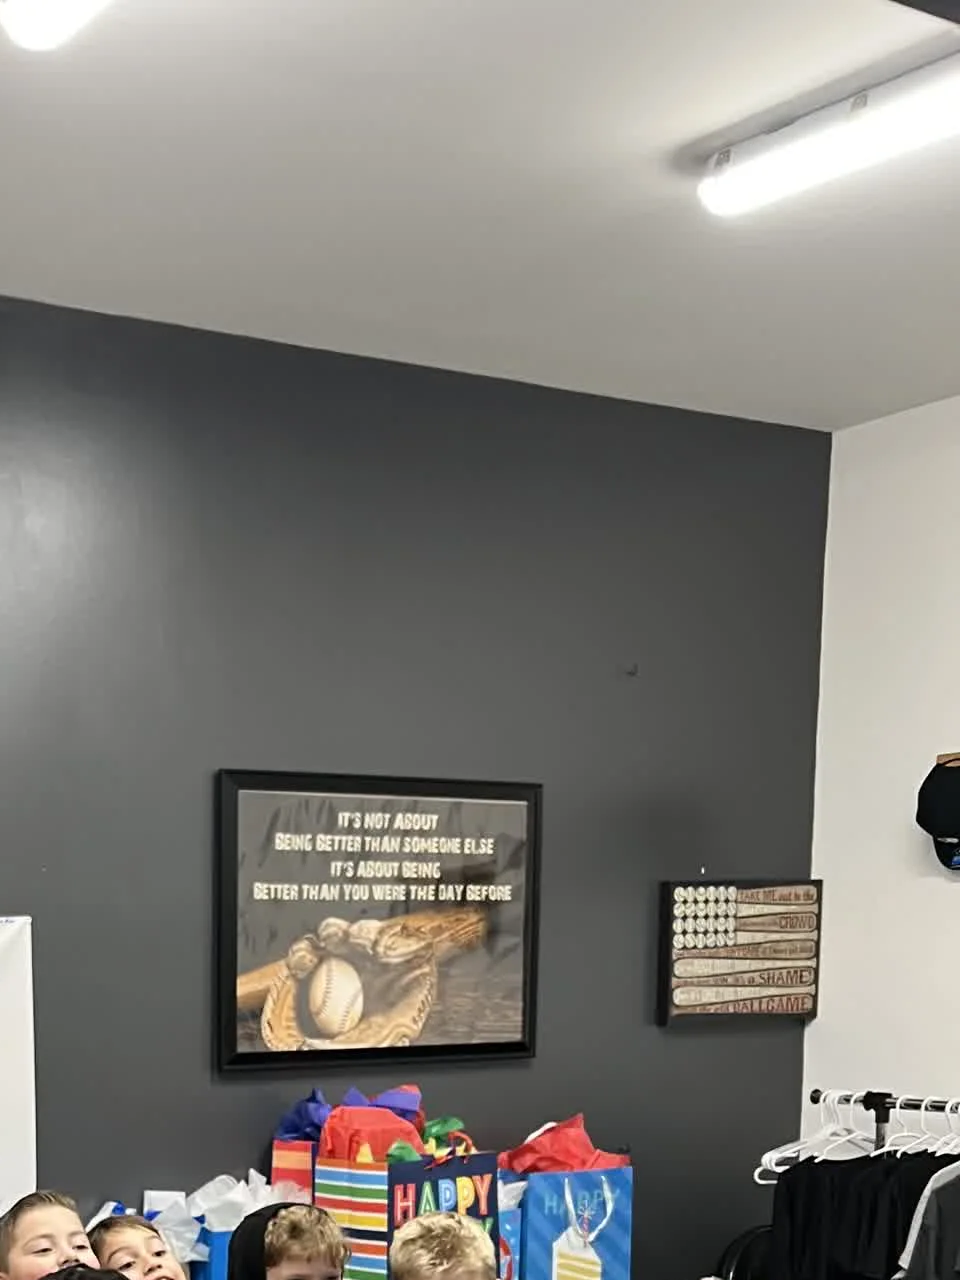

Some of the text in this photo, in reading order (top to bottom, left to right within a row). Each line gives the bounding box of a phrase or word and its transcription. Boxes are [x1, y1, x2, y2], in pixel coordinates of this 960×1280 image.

[338, 812, 439, 830] IT'S NOT ABOUT
[275, 832, 494, 854] BEING BETTER THAN SOMEONE ELSE
[331, 860, 441, 879] IT'S ABOUT BEING
[253, 882, 512, 901] BETTER THAN YOU WERE THE DAY BEFORE
[778, 915, 815, 929] CROWD
[393, 1174, 494, 1229] HAPPY
